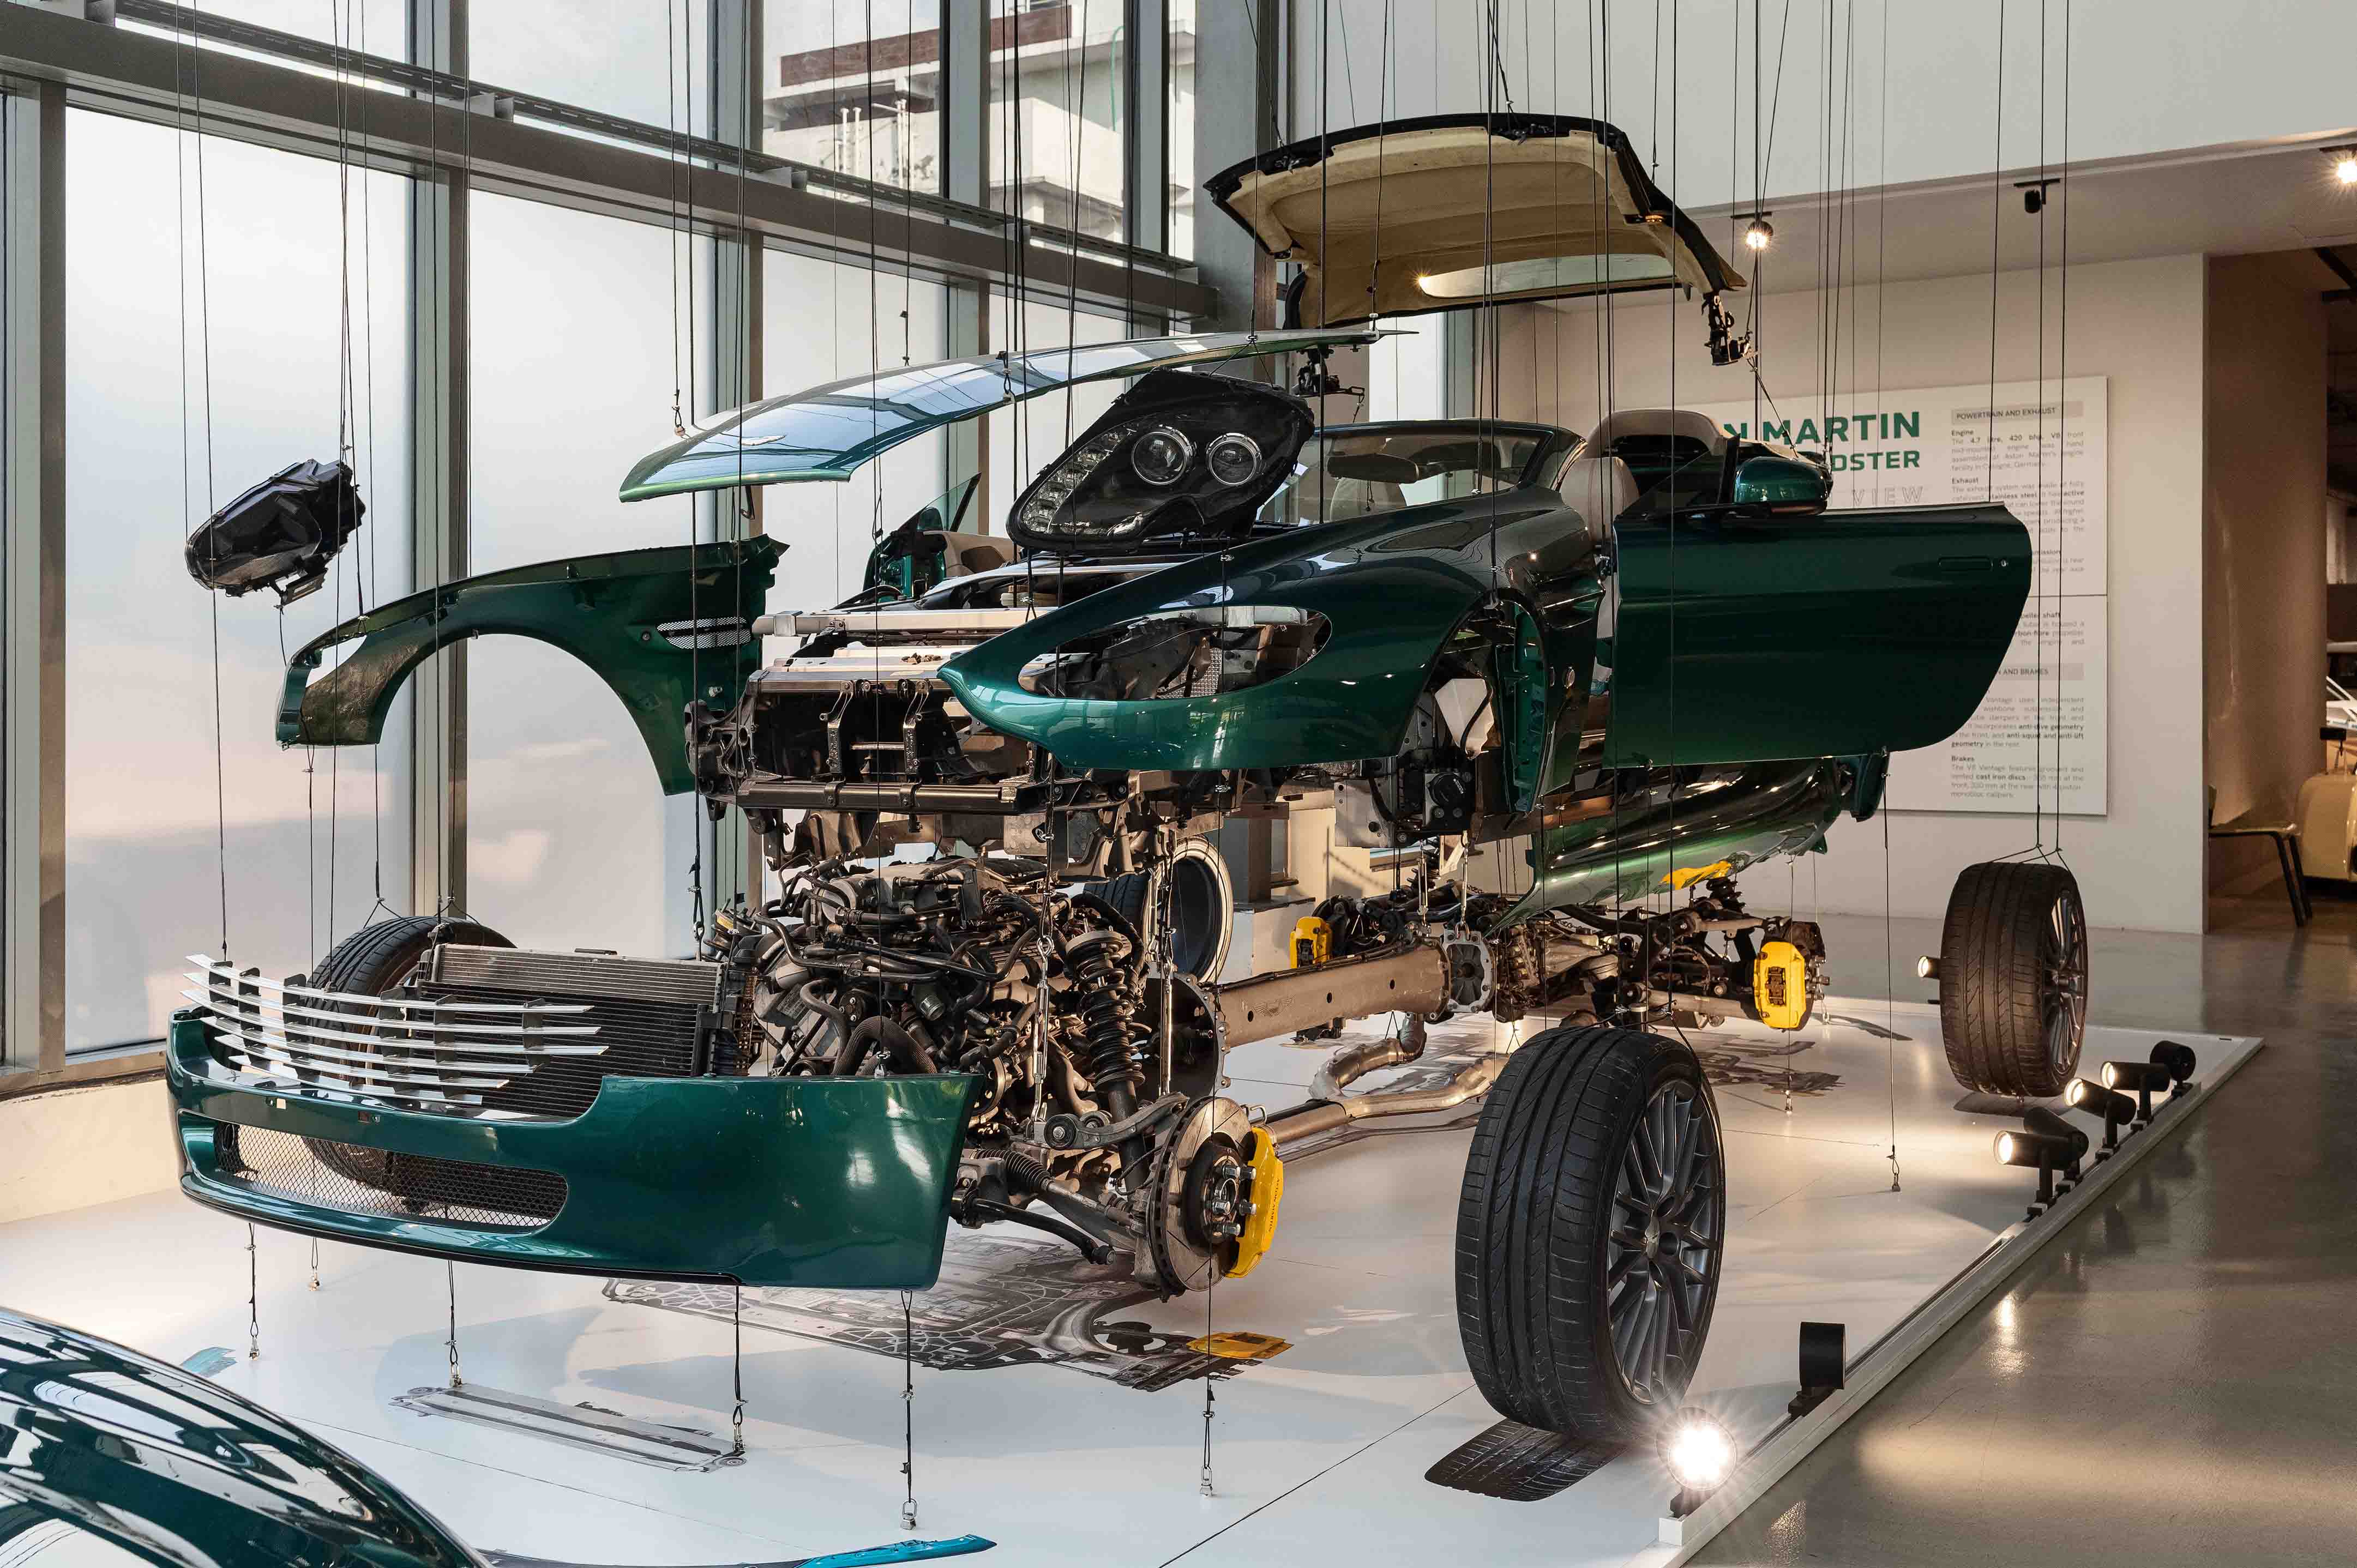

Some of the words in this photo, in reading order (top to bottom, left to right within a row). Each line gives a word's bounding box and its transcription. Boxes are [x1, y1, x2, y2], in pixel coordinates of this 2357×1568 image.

[1957, 410, 2003, 419] POWERTRAIN
[2023, 407, 2055, 415] EXHAUST
[1763, 411, 1920, 445] MARTIN
[1831, 450, 1920, 472] DSTER
[1852, 485, 1923, 506] VIEW
[2020, 667, 2049, 676] BRAKES
